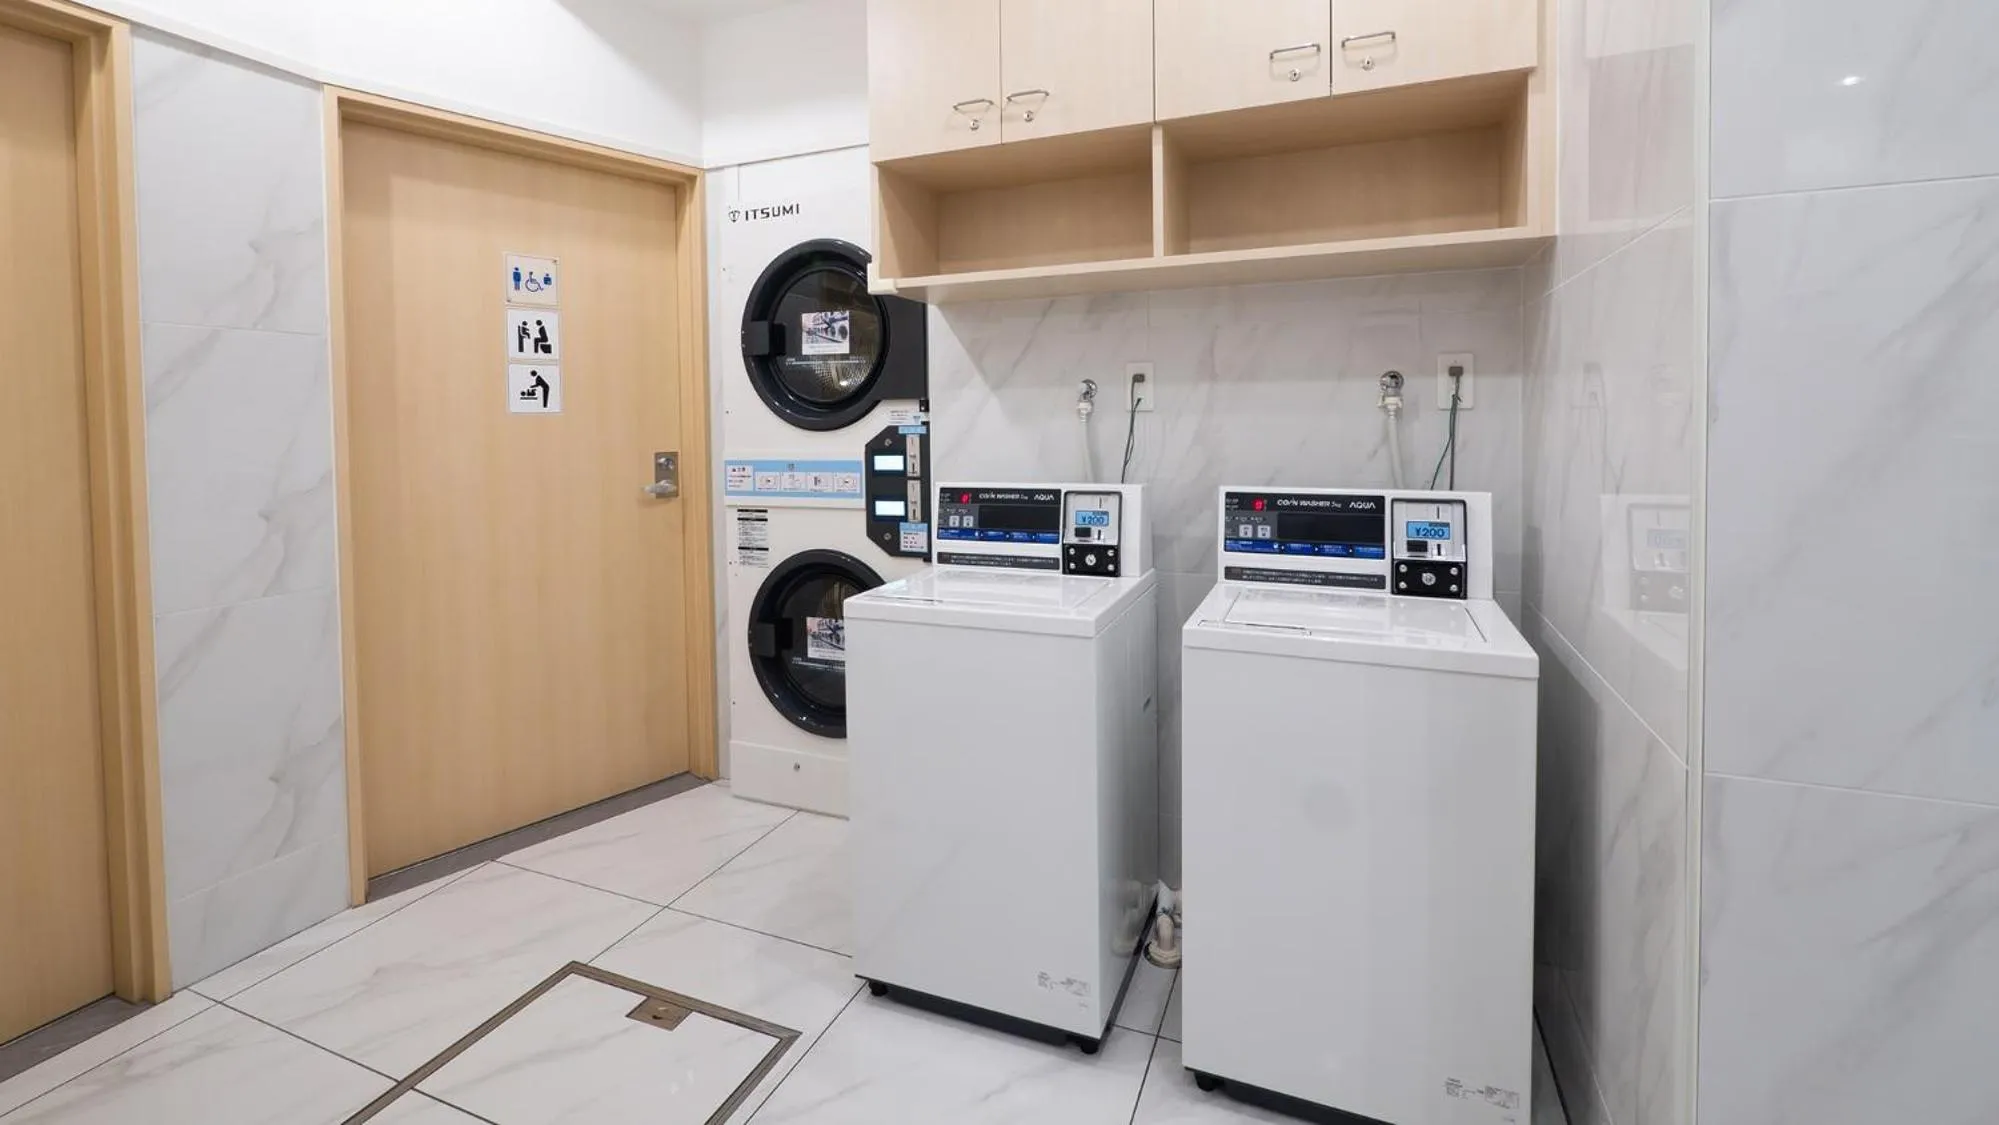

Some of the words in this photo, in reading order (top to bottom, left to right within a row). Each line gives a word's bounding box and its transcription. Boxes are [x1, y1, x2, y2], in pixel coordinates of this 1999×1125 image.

[745, 203, 799, 221] ITSUMI
[1034, 494, 1054, 502] AQUA
[1349, 501, 1376, 510] AQUA
[1415, 527, 1445, 538] ¥200
